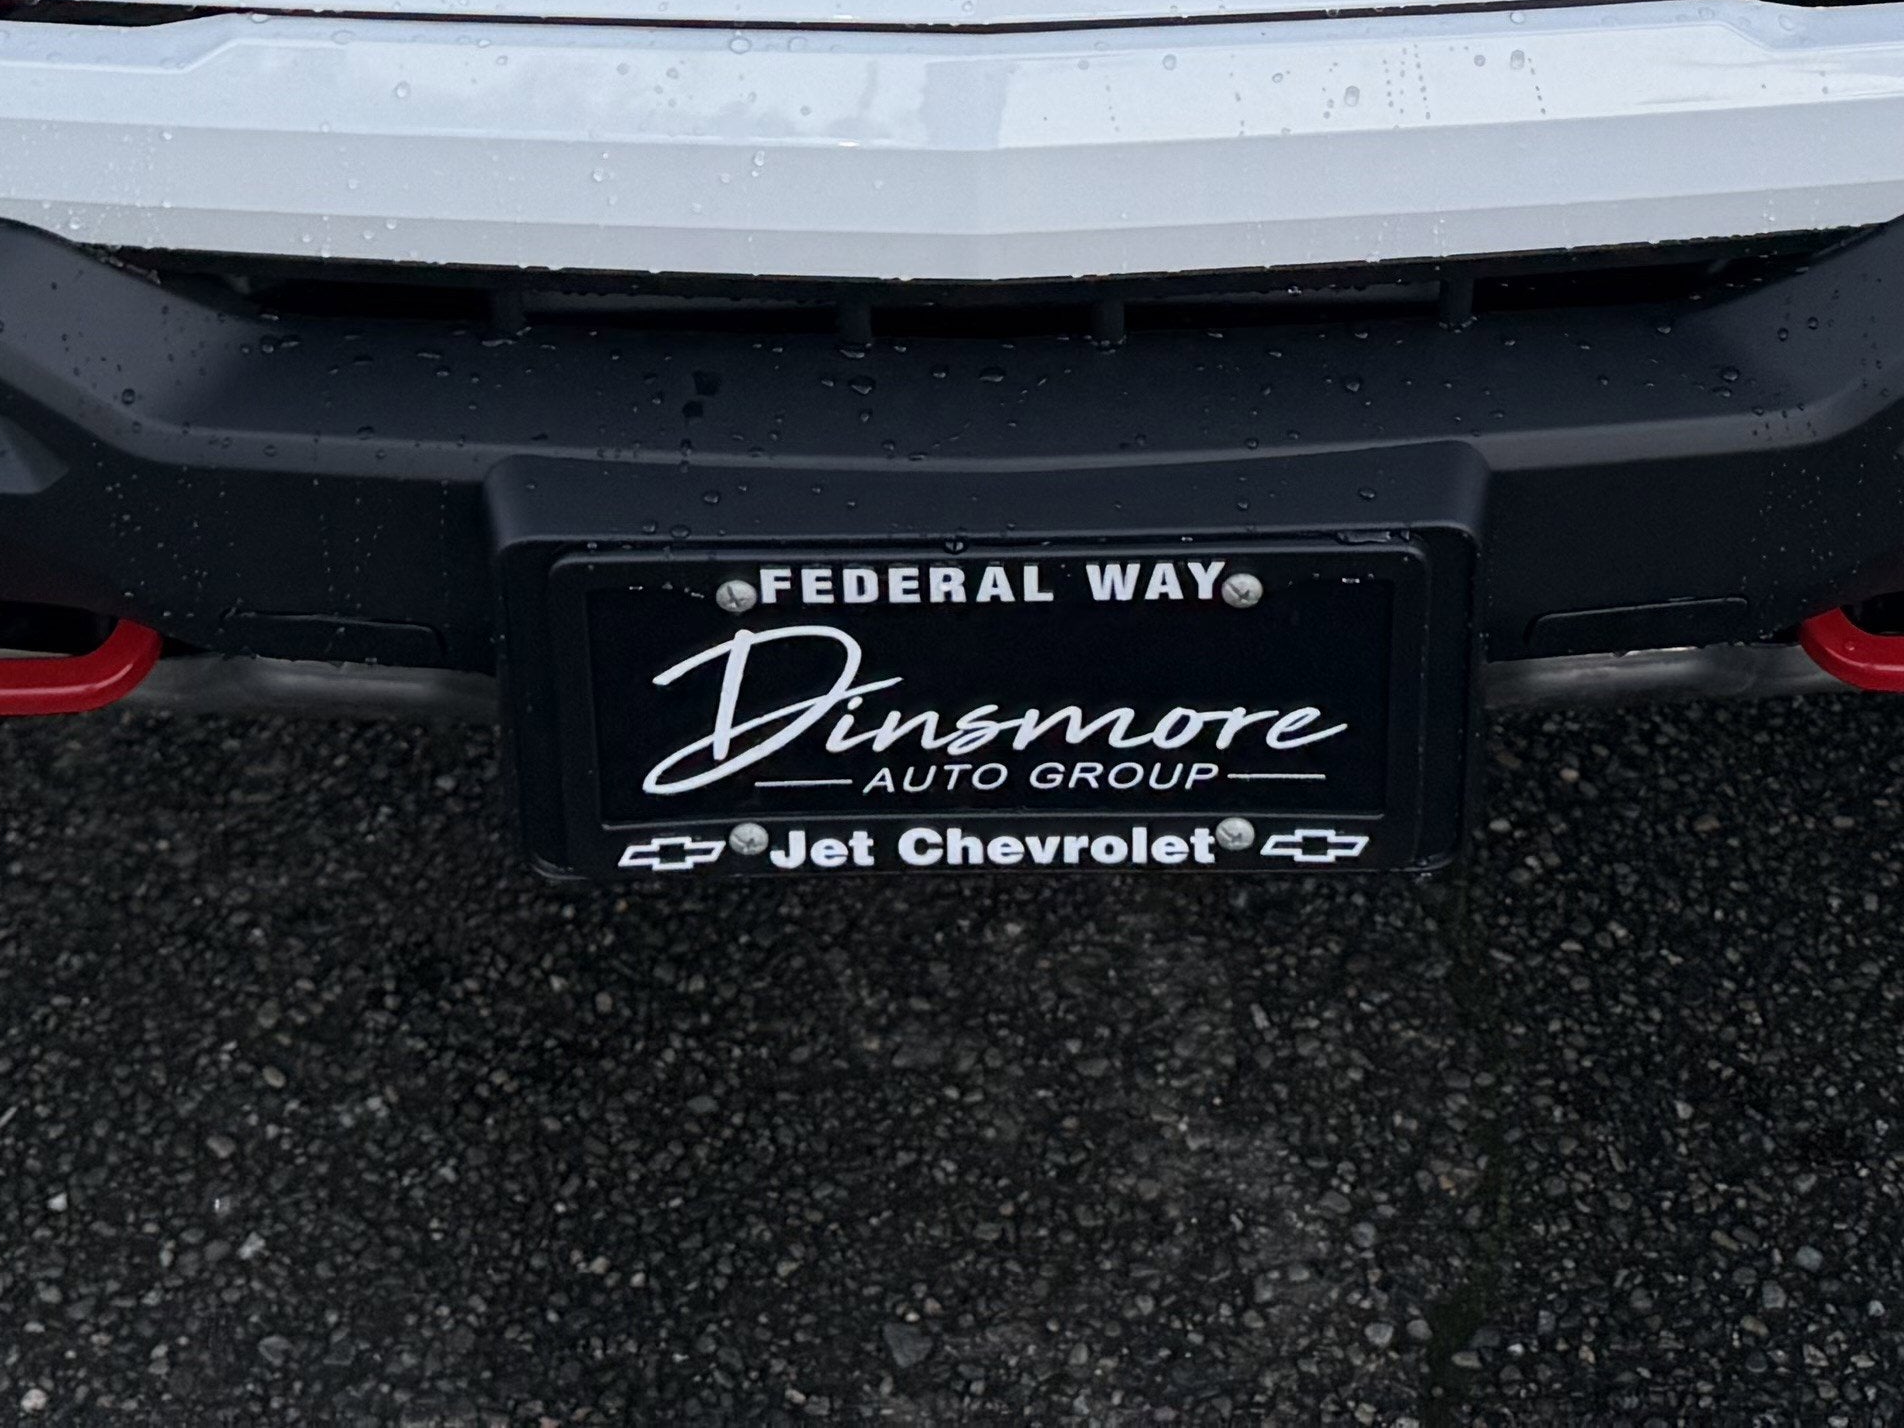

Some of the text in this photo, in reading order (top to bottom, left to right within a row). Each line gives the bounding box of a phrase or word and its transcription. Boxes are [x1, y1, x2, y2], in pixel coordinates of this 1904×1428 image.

[758, 560, 1227, 605] FEDERAL WAY
[641, 624, 1349, 796] Dinsmore
[861, 760, 1220, 795] AUTO GROUP
[768, 825, 1217, 870] Jet Chevrolet
